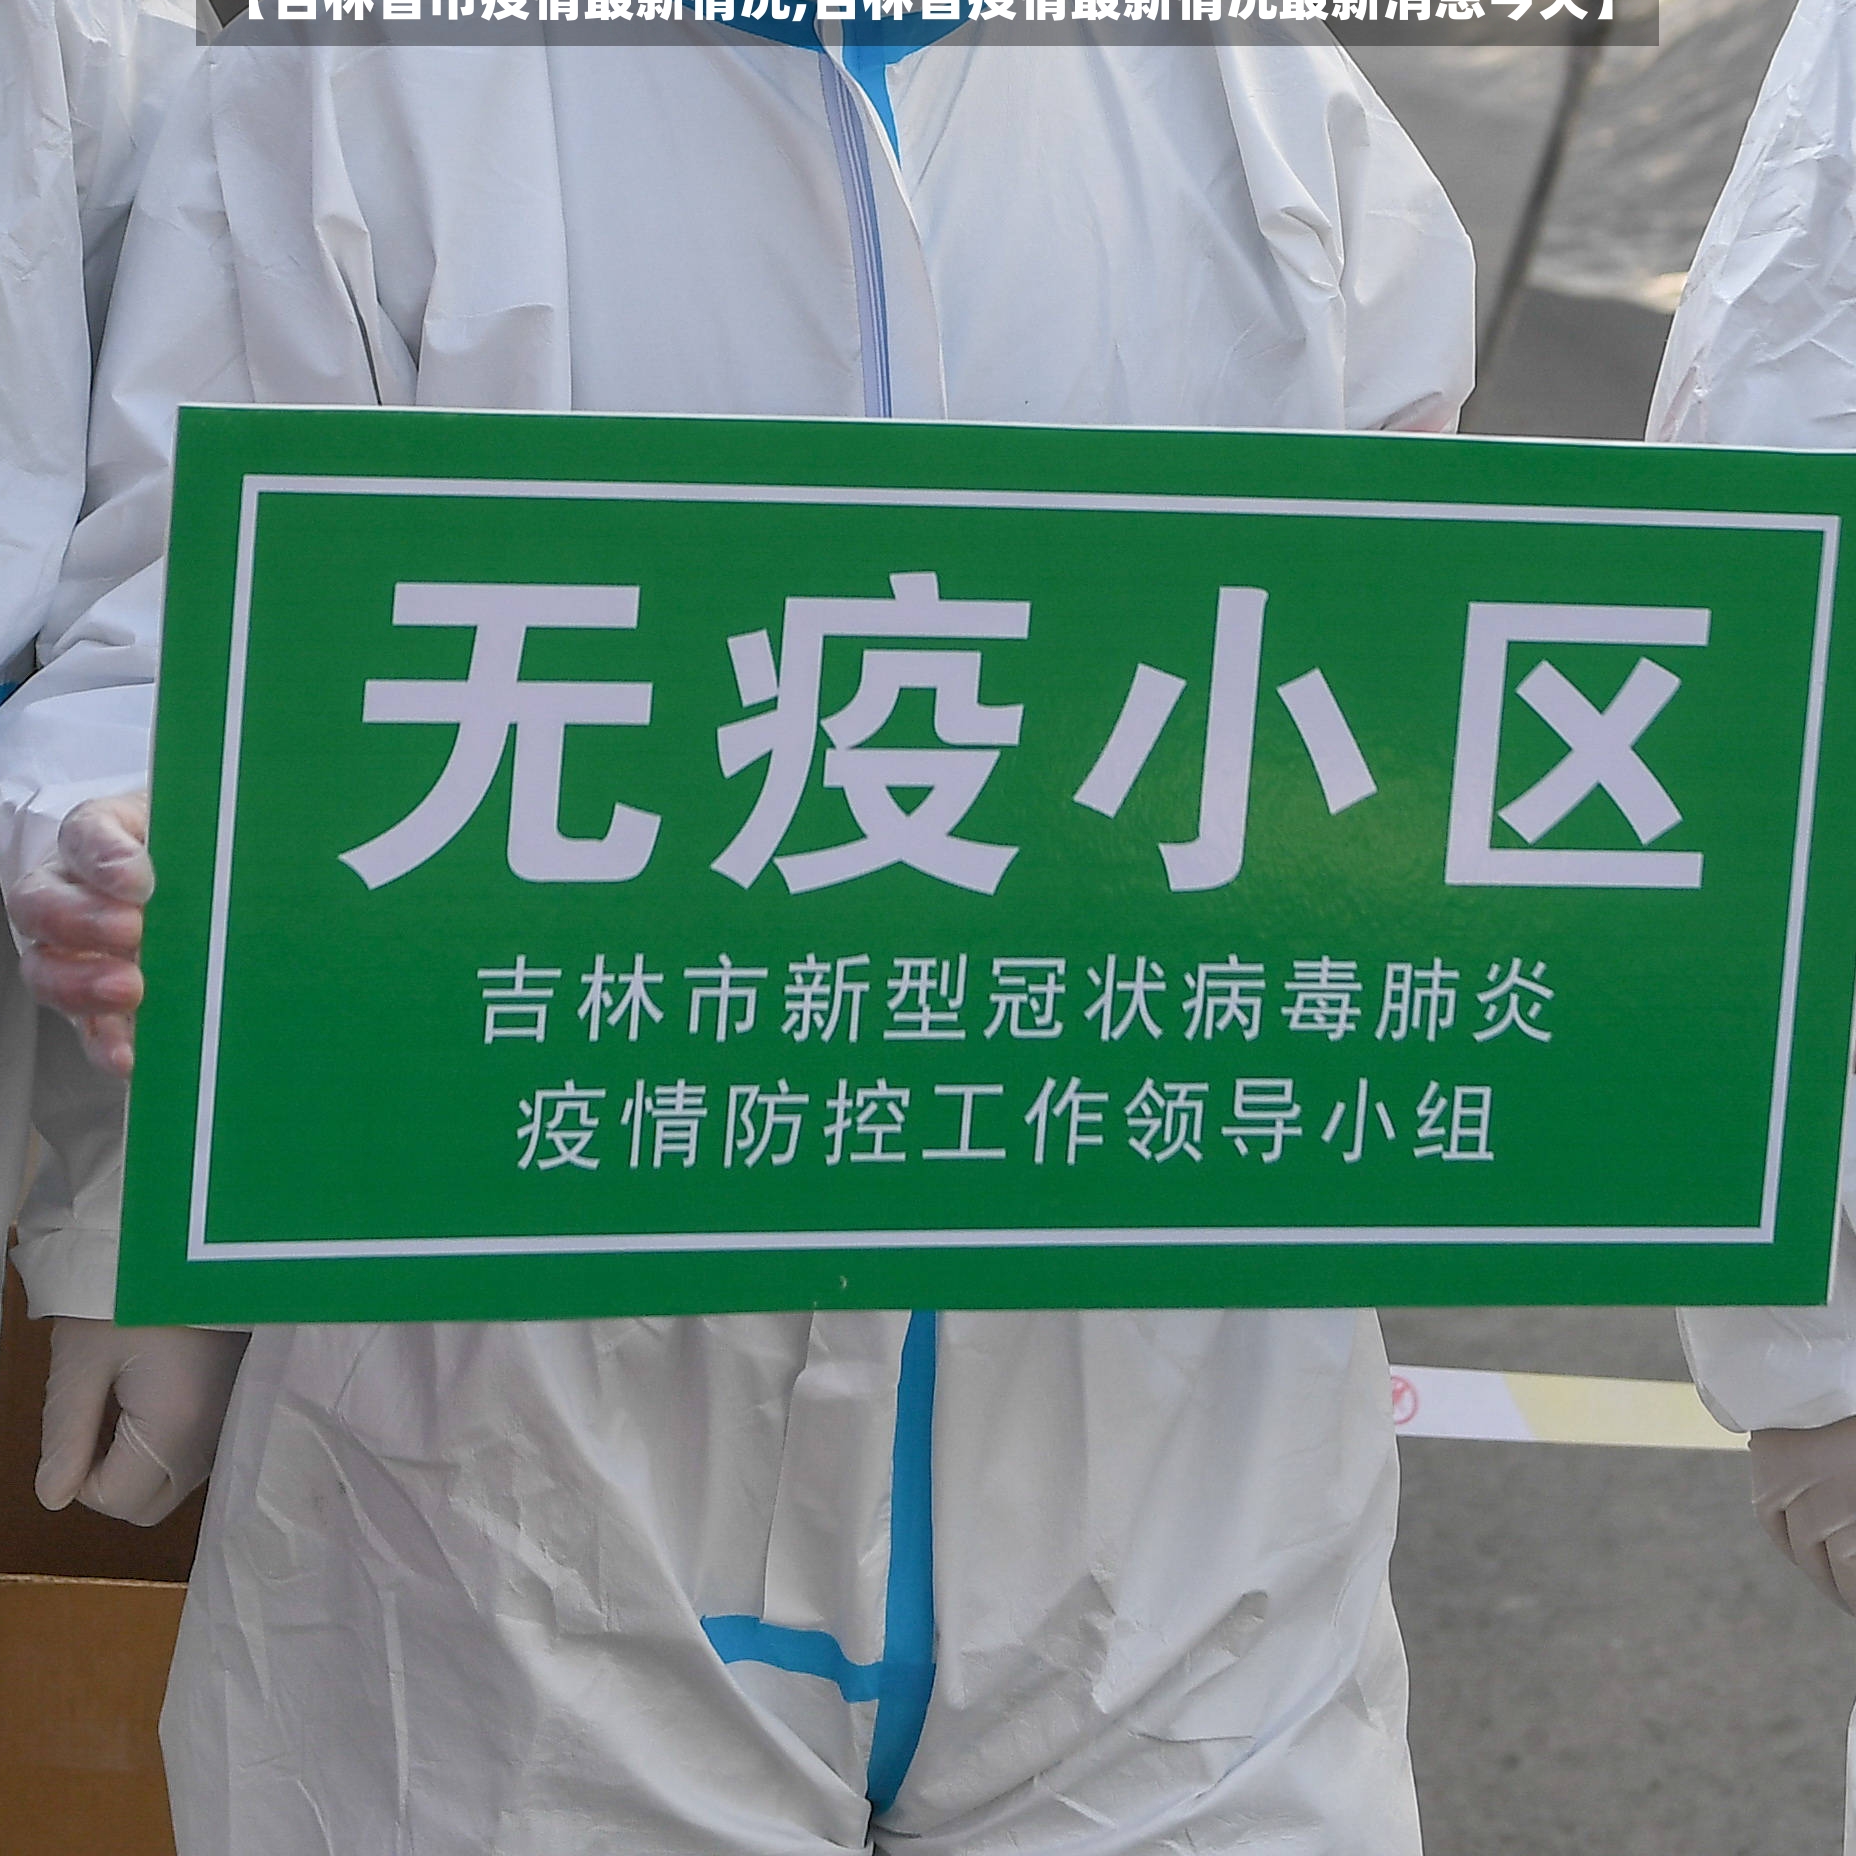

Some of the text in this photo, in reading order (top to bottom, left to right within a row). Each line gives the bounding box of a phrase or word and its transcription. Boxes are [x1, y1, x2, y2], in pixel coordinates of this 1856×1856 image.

[339, 572, 1711, 894] 无疫小区
[477, 952, 1556, 1044] 吉林市新型冠状病毒肺炎
[516, 1077, 1496, 1171] 疫情防控工作领导小组
